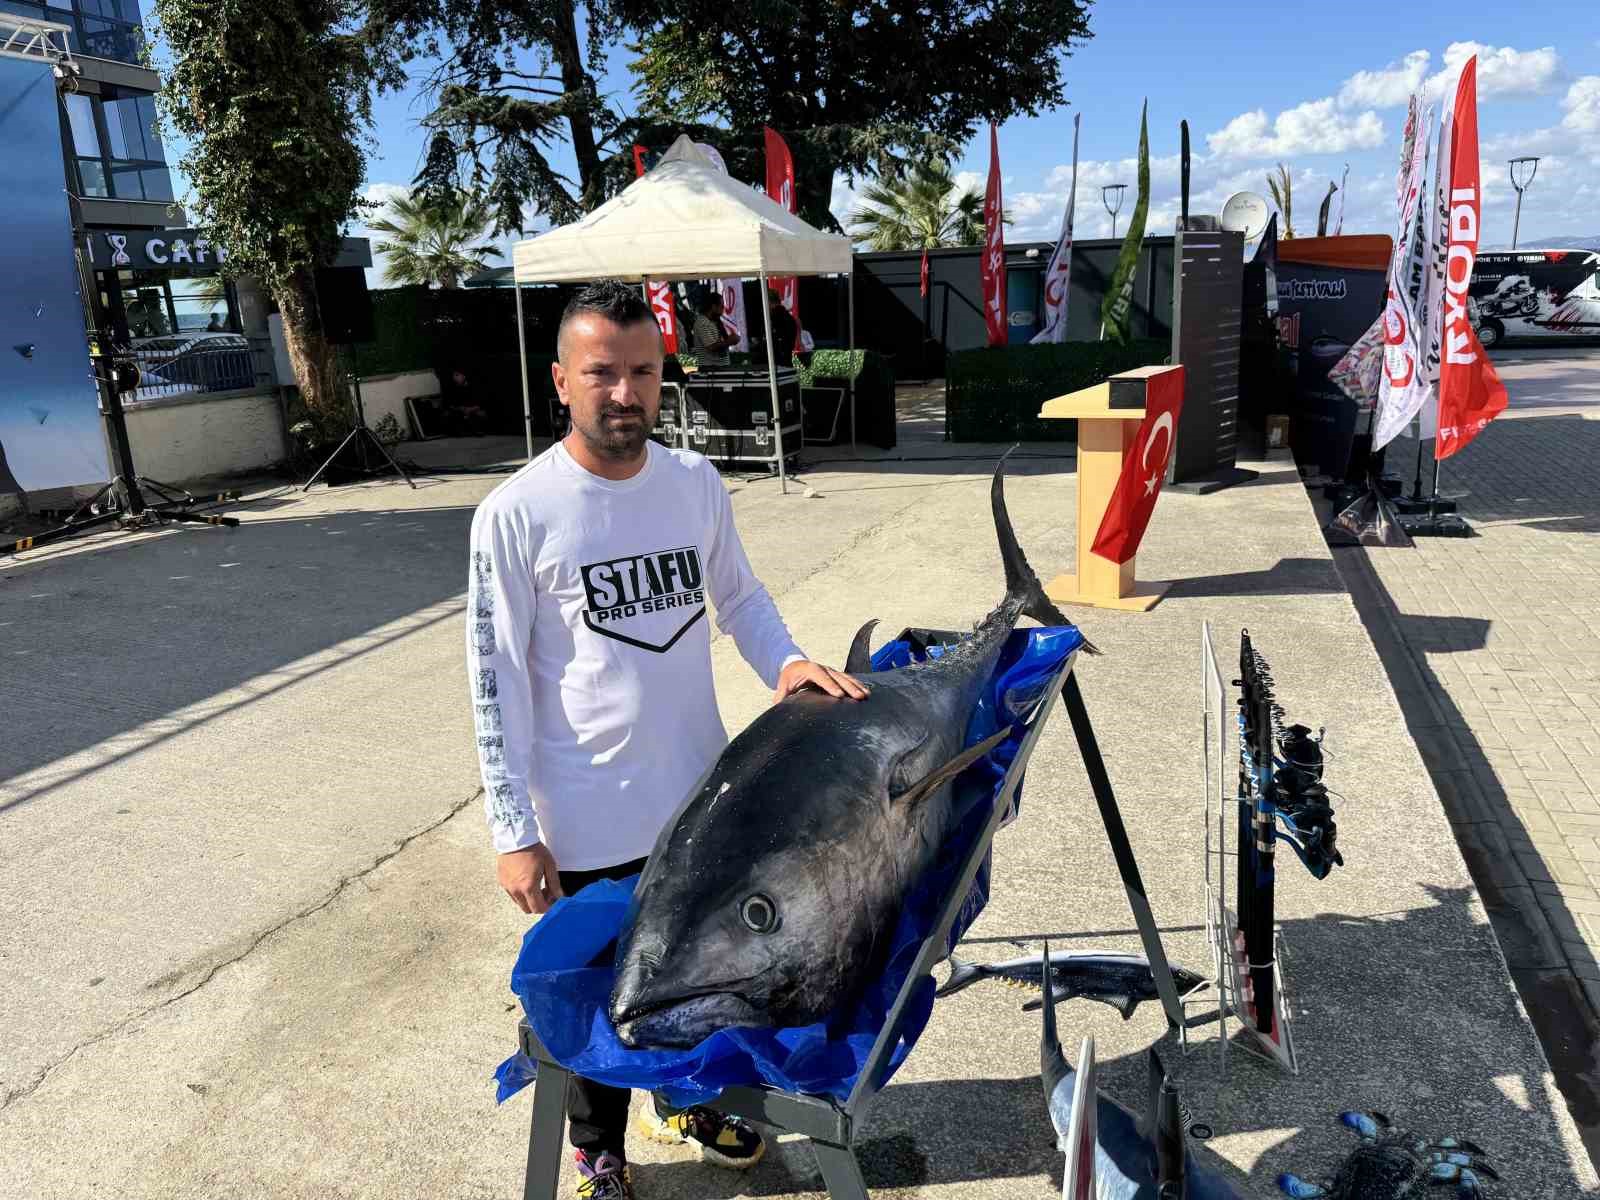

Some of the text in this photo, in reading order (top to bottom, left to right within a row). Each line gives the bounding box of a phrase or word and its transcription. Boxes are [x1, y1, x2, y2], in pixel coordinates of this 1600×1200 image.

[1523, 255, 1546, 263] YAMAHA
[589, 549, 701, 608] STAFU
[597, 591, 704, 623] PRO SERIES
